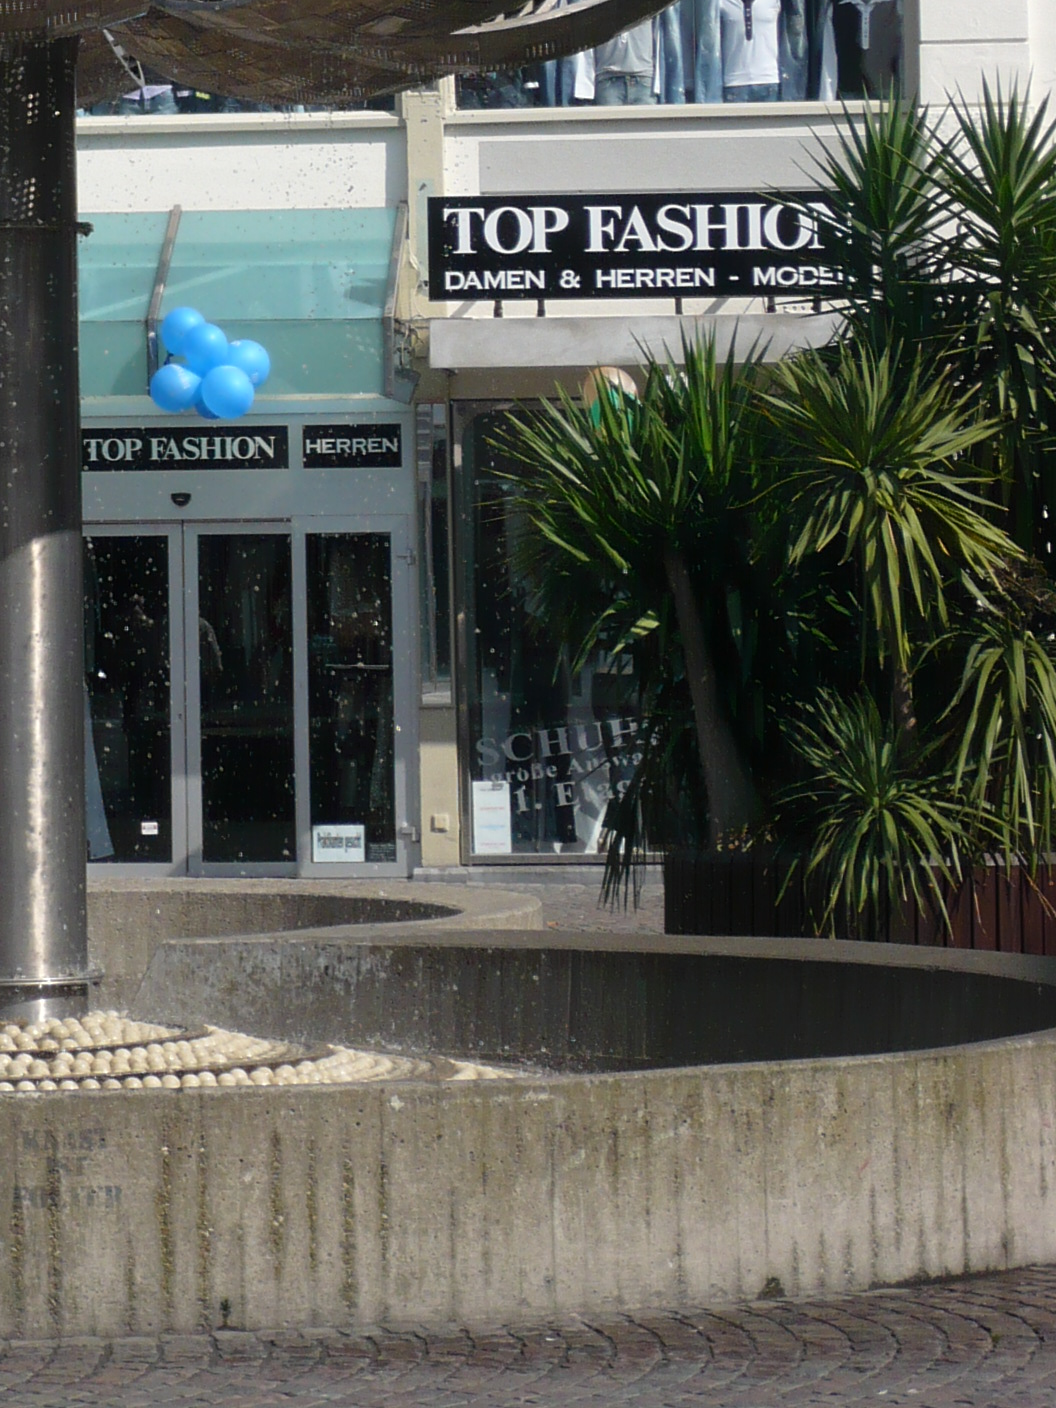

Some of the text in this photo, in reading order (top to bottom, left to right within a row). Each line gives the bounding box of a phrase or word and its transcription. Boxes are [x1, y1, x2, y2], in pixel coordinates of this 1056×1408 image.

[444, 206, 569, 254] TOP
[445, 269, 545, 290] DAMEN
[559, 267, 581, 289] &
[596, 266, 716, 289] HERREN
[83, 436, 276, 462] TOP FASHION
[305, 437, 399, 455] HERREN
[514, 785, 543, 815] 1.
